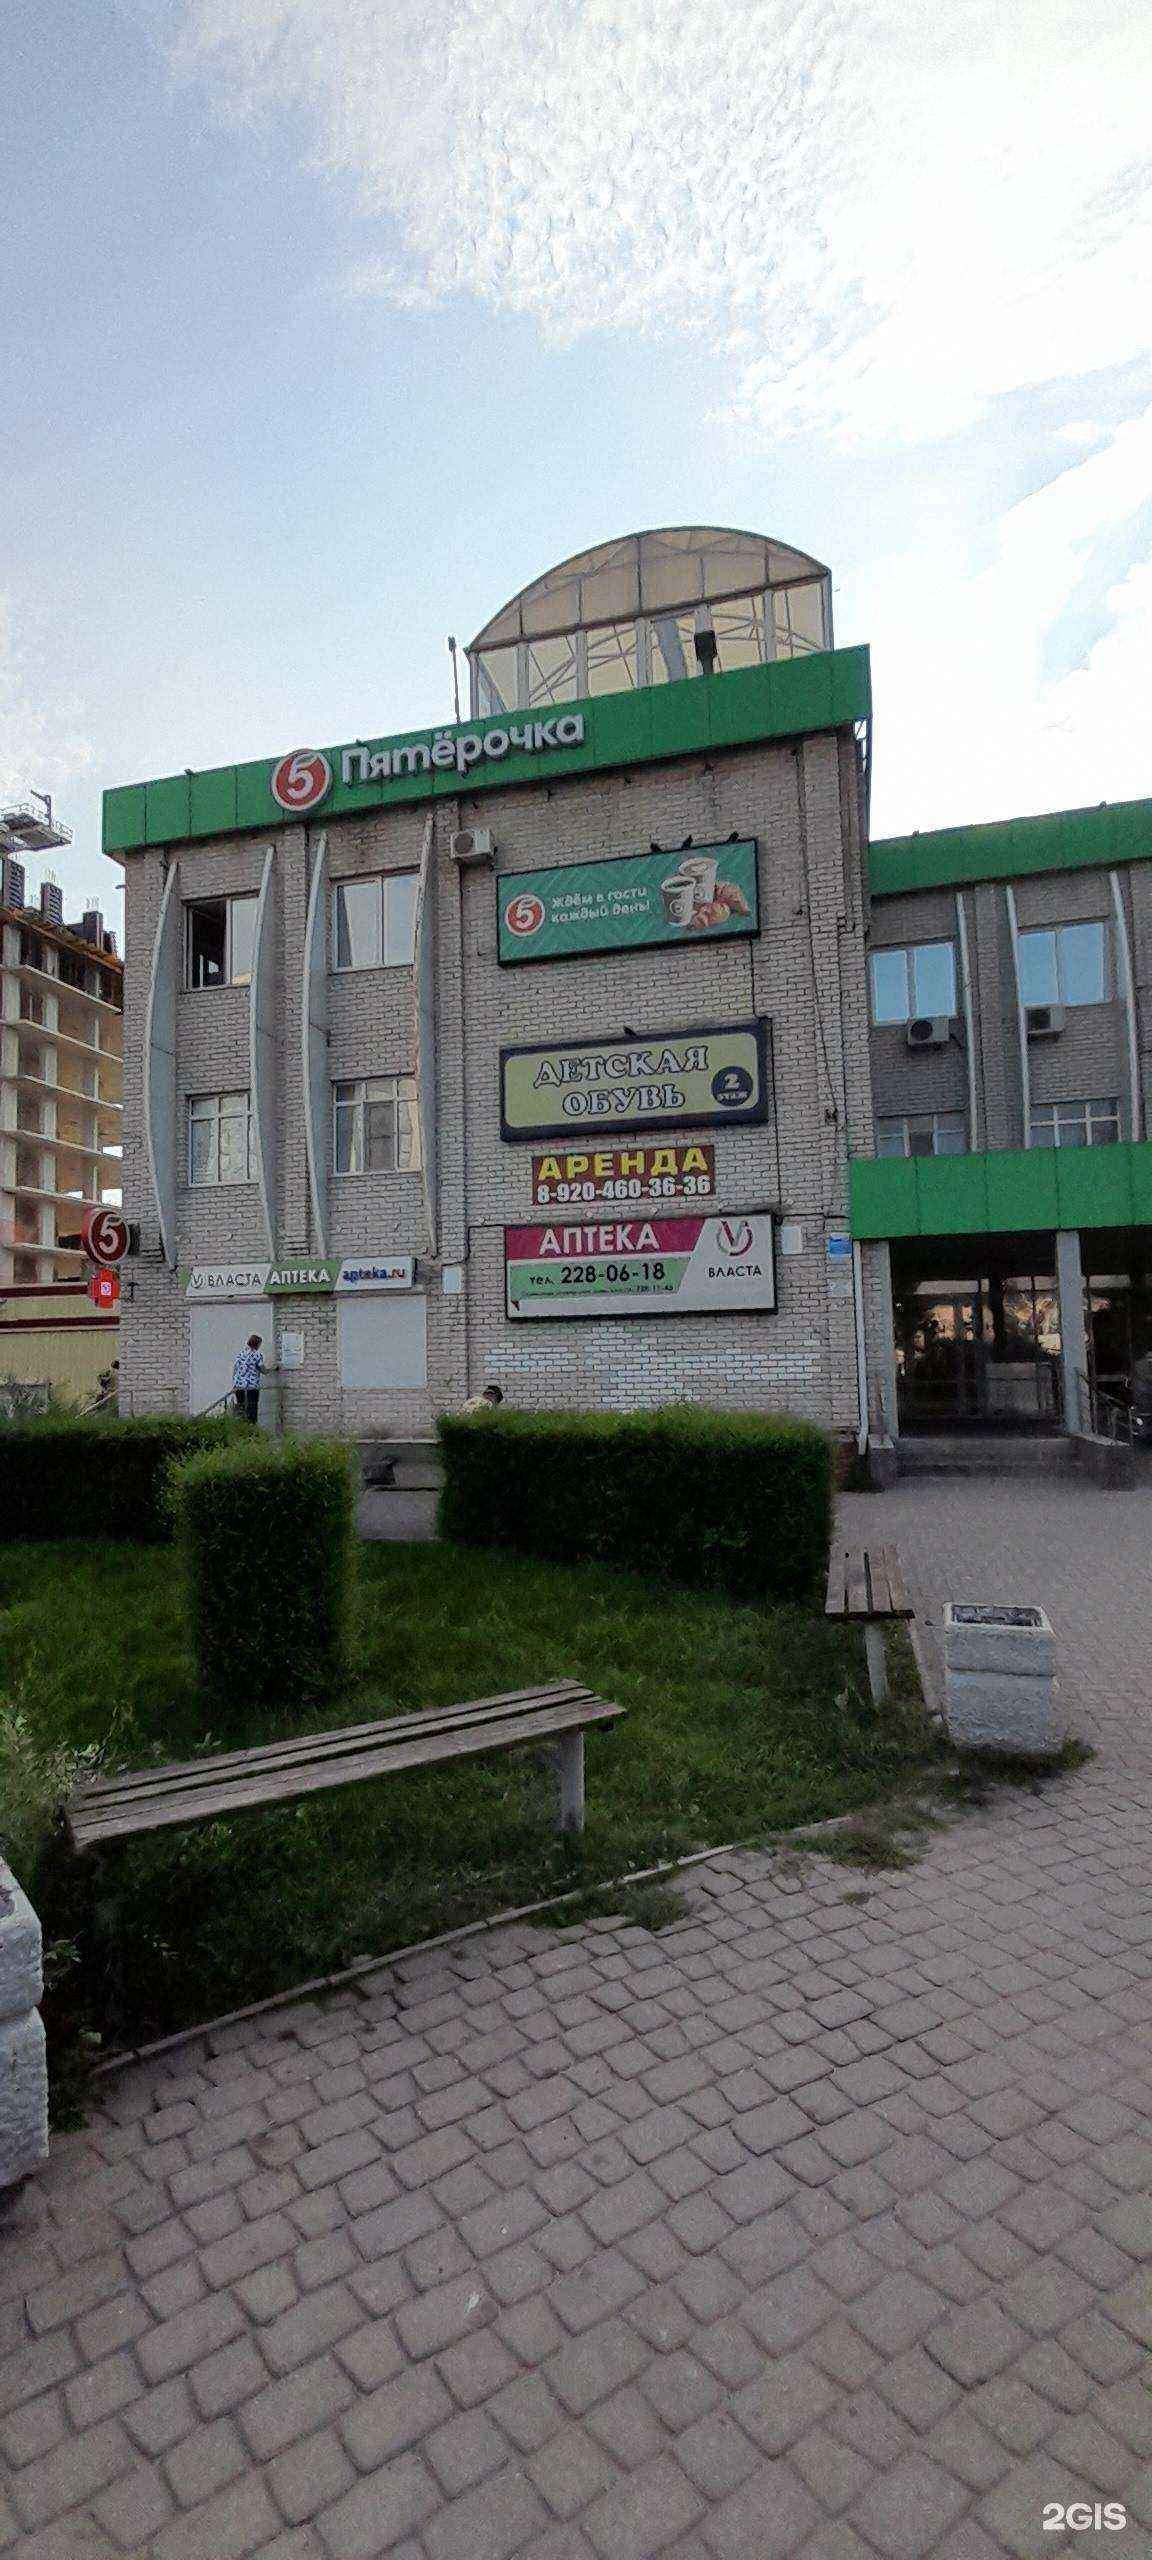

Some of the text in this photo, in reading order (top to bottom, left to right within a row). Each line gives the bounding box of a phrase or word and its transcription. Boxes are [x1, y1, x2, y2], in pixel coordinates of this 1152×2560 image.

[286, 714, 584, 799] 5 Пятёрочка
[552, 887, 647, 907] Ждём в гости
[516, 896, 536, 926] 5
[552, 904, 609, 924] каждый
[533, 1045, 709, 1089] ДЕТСКАЯ
[724, 1074, 740, 1089] 2
[563, 1083, 685, 1116] ОБУВЬ
[538, 1147, 709, 1180] АРЕНДА
[537, 1175, 711, 1204] 8-920-460-36-36
[99, 1213, 123, 1254] 5
[539, 1223, 660, 1255] АПТЕКА
[208, 1273, 261, 1287] ВЛАСТА
[270, 1268, 331, 1285] АПТЕКА
[342, 1267, 406, 1283] apteka.ru
[560, 1262, 665, 1284] 228-06-18
[708, 1265, 762, 1279] ВЛАСТА
